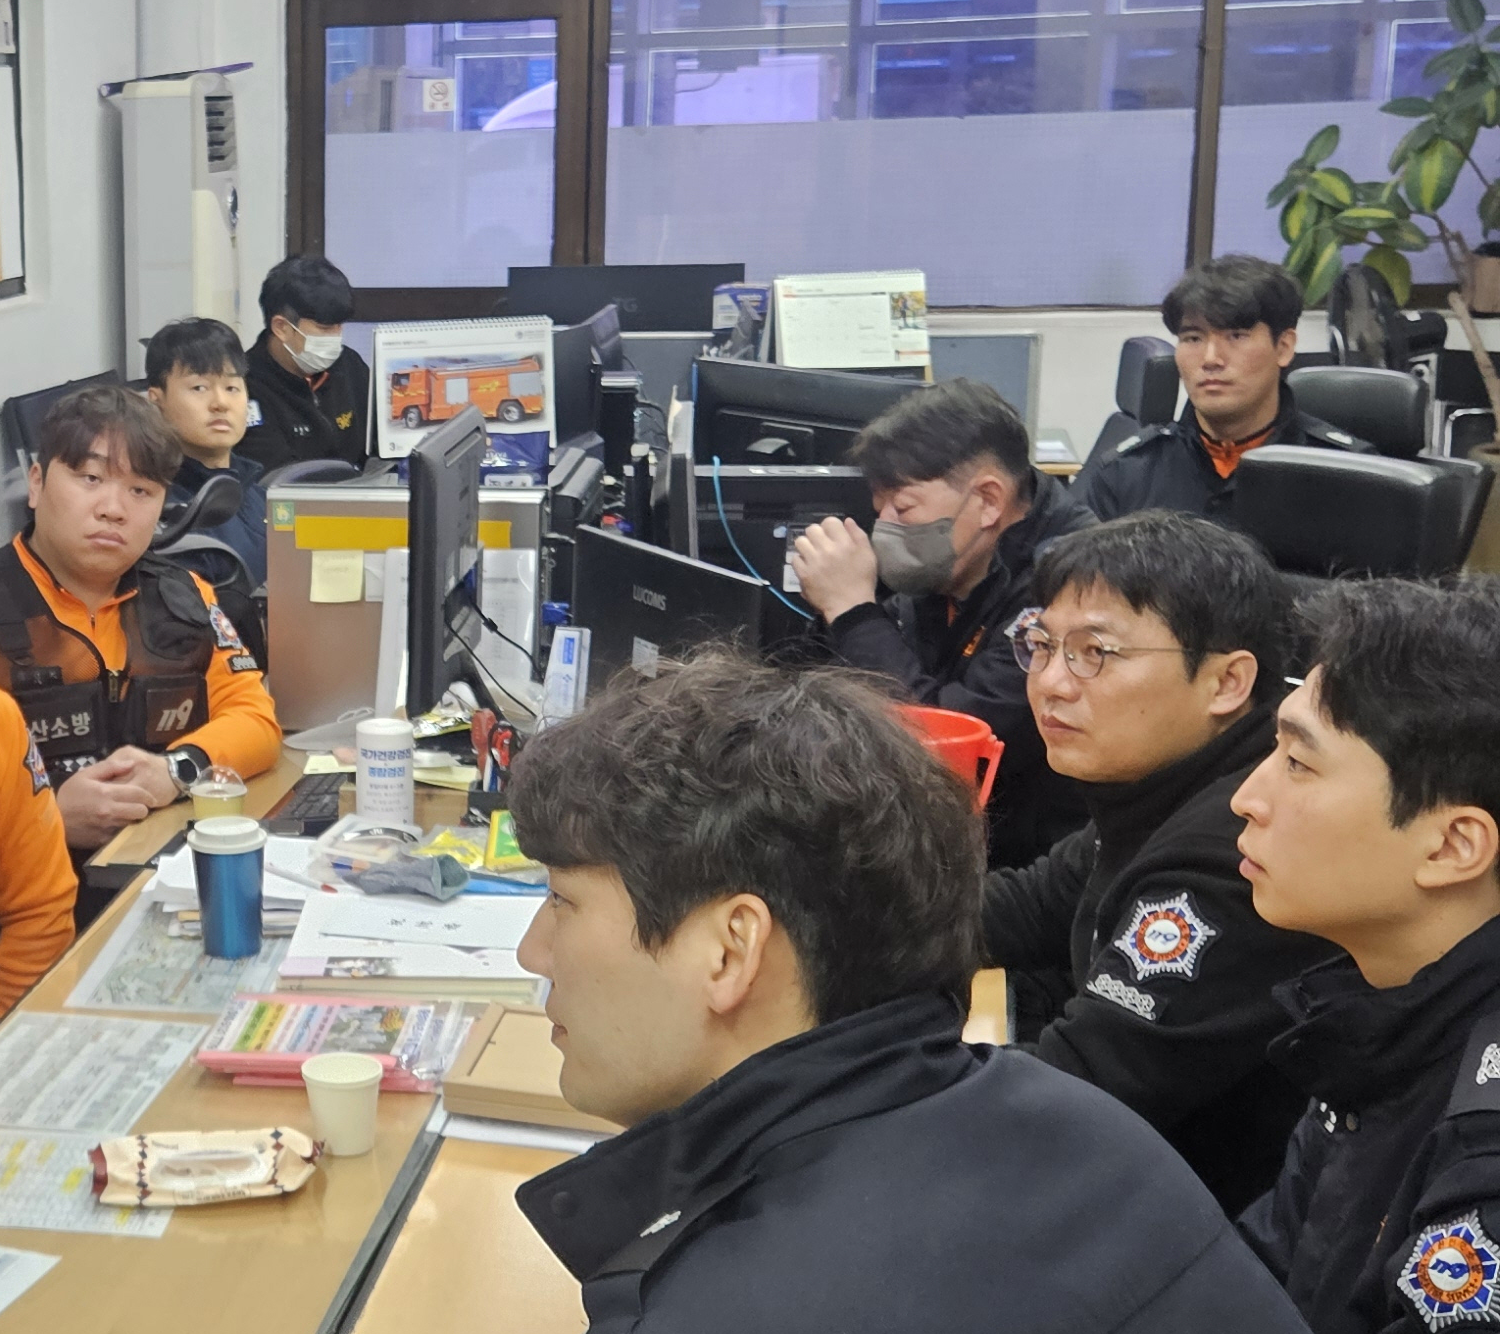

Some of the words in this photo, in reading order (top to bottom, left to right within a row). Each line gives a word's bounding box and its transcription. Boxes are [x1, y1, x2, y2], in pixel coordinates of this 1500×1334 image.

[389, 442, 397, 452] 3
[632, 584, 667, 611] LUCOMS
[31, 711, 91, 743] 산소방
[156, 698, 194, 732] 119
[360, 748, 411, 762] 국가건강검진
